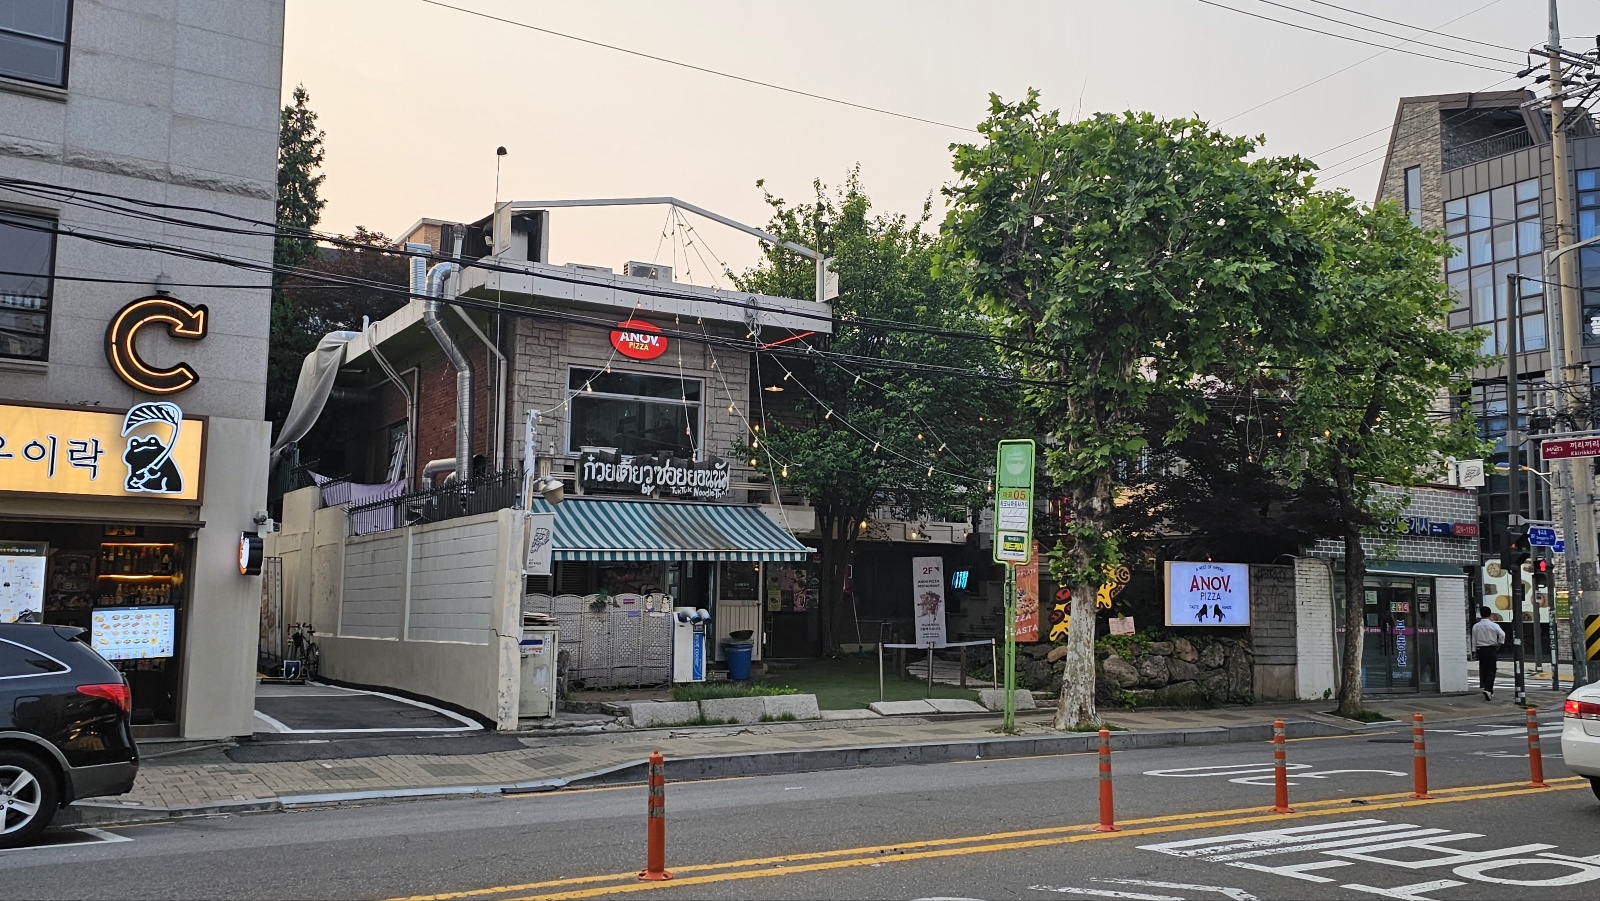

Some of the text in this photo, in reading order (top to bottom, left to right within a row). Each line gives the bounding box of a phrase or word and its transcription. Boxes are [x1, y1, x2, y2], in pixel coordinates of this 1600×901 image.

[628, 341, 649, 351] PIZZA
[1569, 439, 1600, 450] 끼리끼리
[0, 434, 105, 481] 이락
[1570, 448, 1597, 456] Kkirikkiri
[641, 483, 656, 496] by
[1013, 489, 1026, 500] 05
[922, 567, 933, 575] 2F
[1189, 575, 1232, 593] ANOV.
[1200, 592, 1221, 601] PIZZA
[1395, 619, 1408, 667] 부동산
